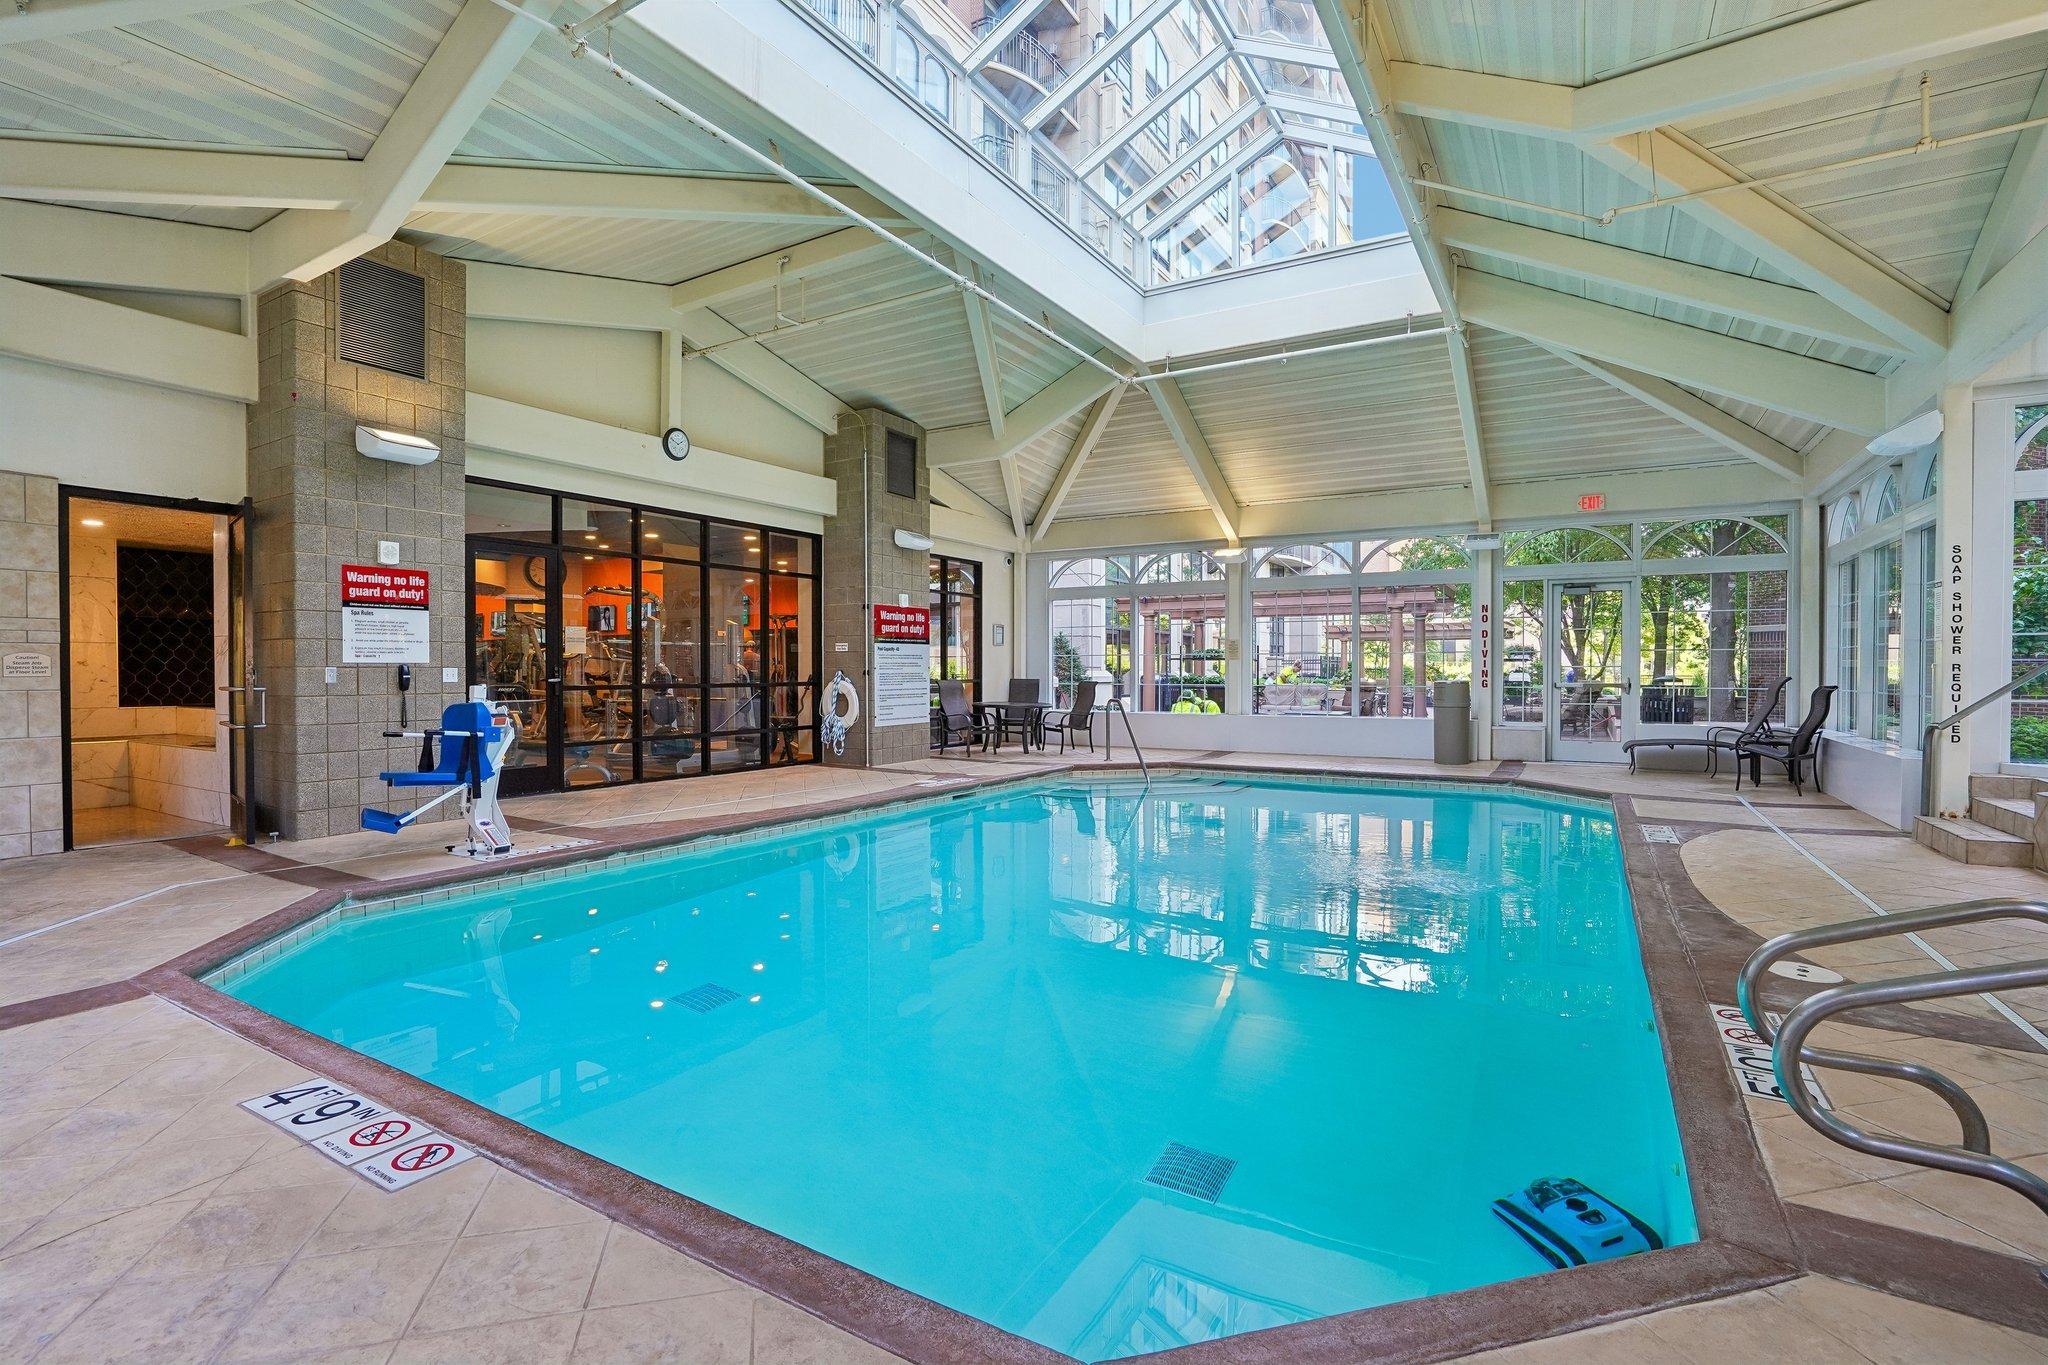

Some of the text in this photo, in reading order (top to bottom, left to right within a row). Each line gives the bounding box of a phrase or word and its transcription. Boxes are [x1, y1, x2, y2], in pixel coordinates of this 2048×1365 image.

[1582, 496, 1600, 510] EXIT
[346, 571, 425, 586] Warning no life
[348, 587, 424, 601] guard on duty!
[880, 610, 925, 622] Warning no life
[1482, 604, 1488, 623] NO
[882, 624, 899, 634] guard
[910, 625, 924, 635] duty!
[1950, 545, 1964, 743] SOAP SHOWER REQUIED
[262, 1086, 344, 1109] 4 FT
[291, 1099, 381, 1125] 9 IN
[331, 1146, 353, 1159] DIVING
[373, 1170, 397, 1184] RUNNING
